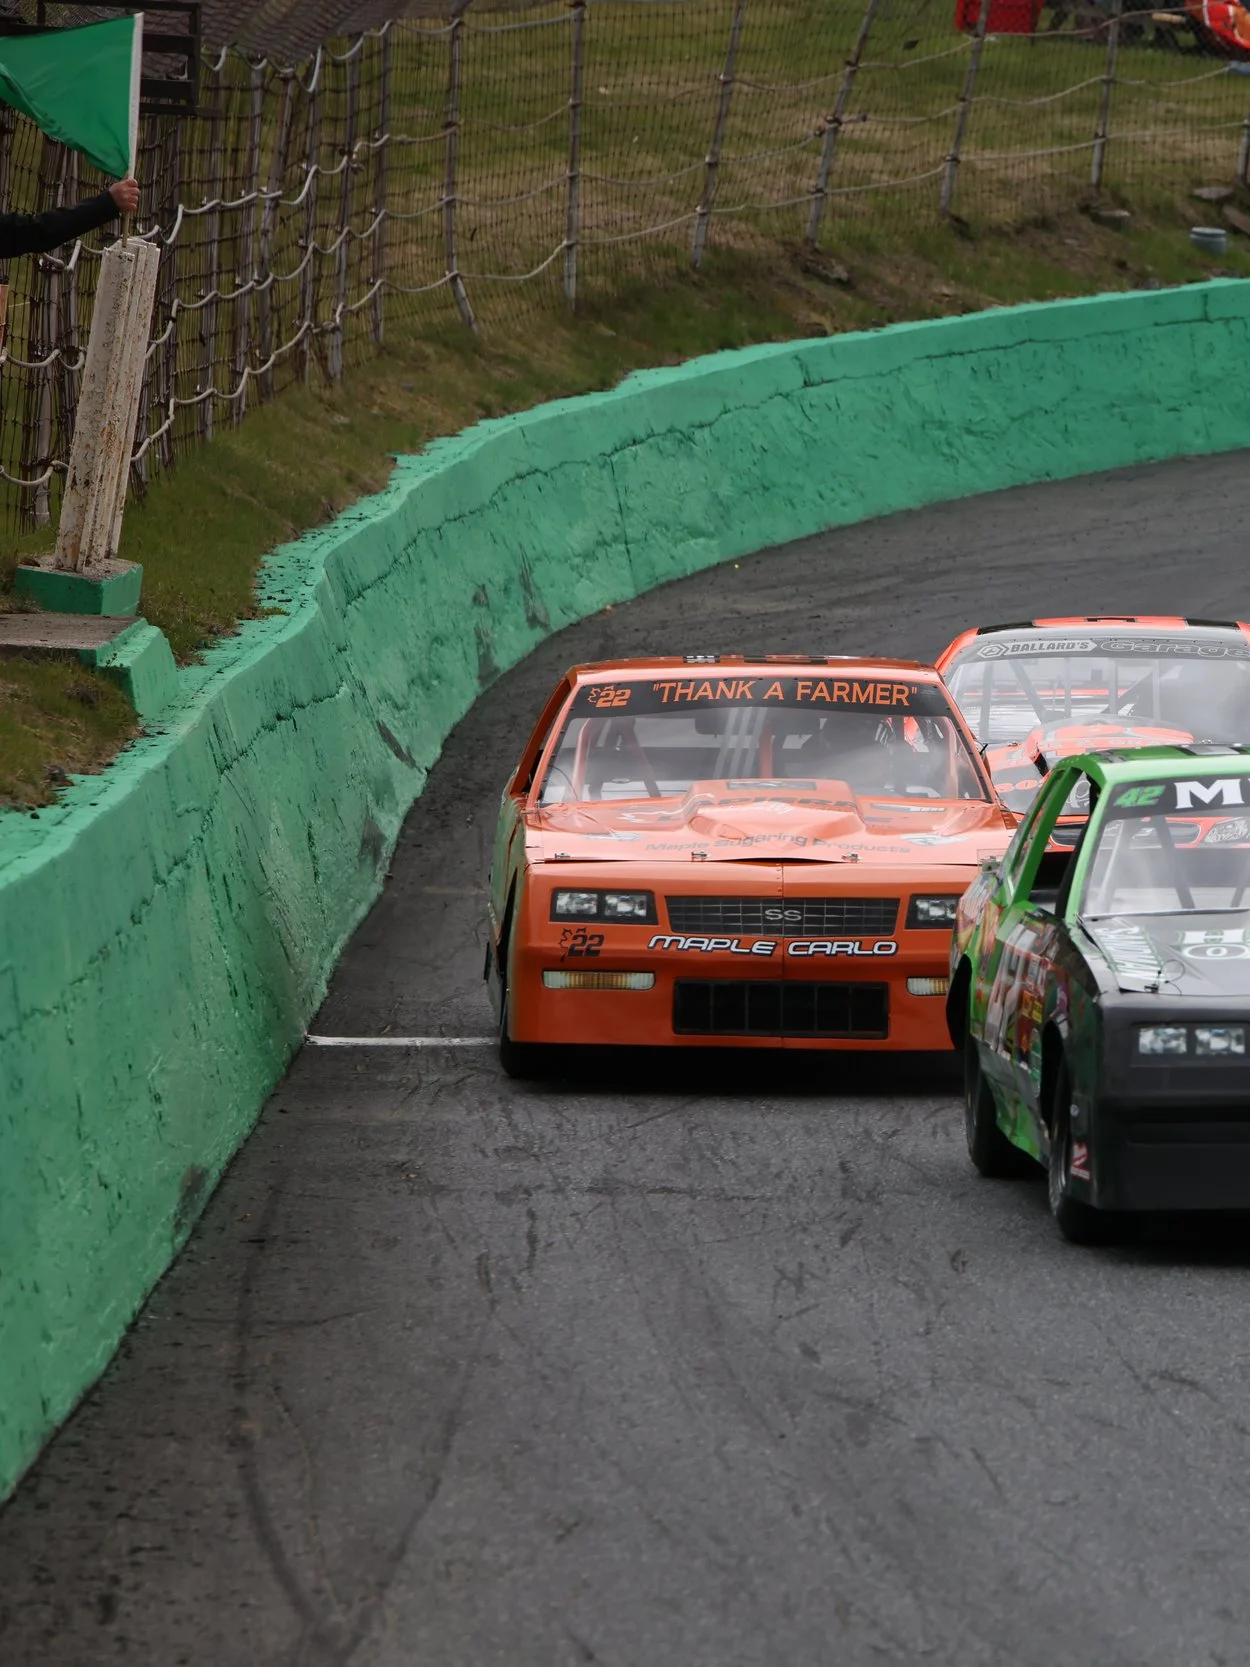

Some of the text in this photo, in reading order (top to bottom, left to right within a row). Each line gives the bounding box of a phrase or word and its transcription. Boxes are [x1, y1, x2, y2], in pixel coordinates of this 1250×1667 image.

[1010, 640, 1090, 653] BALLARD'S
[594, 681, 918, 707] 22 "THANK A FARMER"
[1113, 784, 1166, 808] 42
[645, 831, 911, 854] Maple Sugaring Products
[764, 909, 802, 922] SS
[567, 933, 898, 957] 22 MAPLE CARLO
